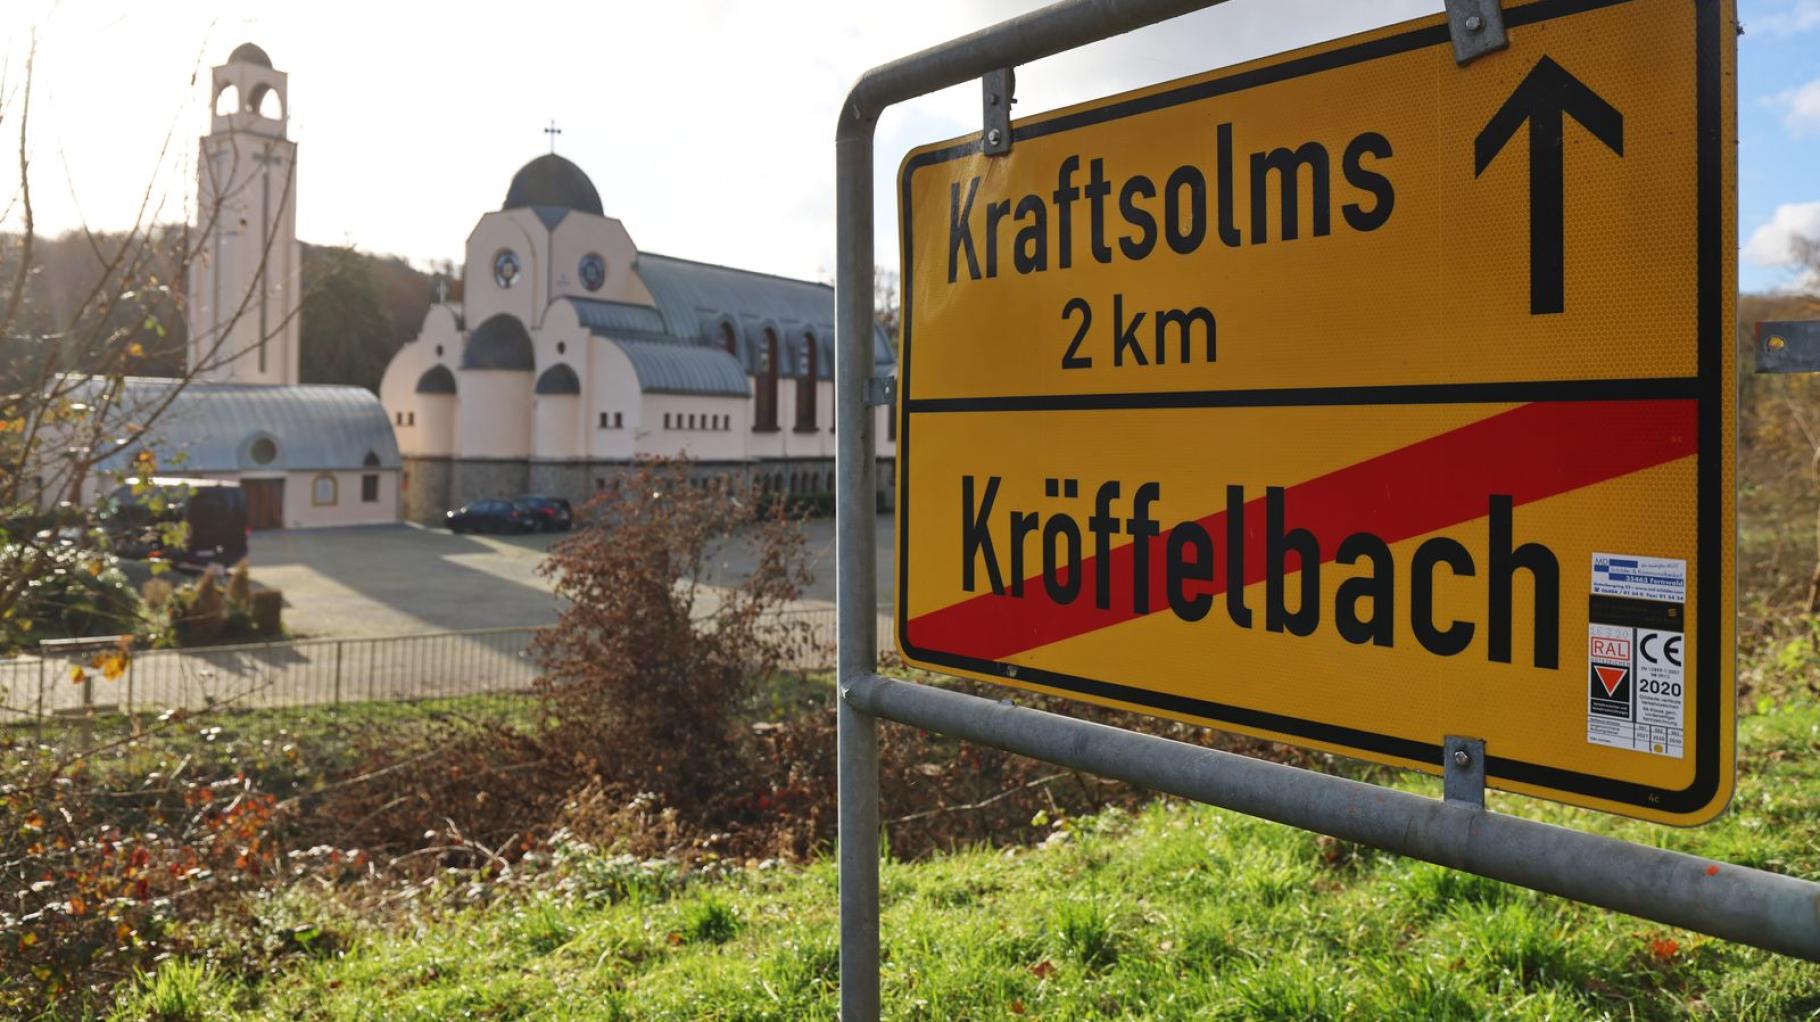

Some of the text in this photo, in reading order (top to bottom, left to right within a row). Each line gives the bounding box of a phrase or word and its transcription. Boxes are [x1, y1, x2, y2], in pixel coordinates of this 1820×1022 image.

[949, 122, 1394, 282] Kraftsolms
[1063, 295, 1216, 369] 2 km
[961, 475, 1560, 670] Kröffelbach
[1594, 640, 1626, 657] RAL
[1640, 634, 1681, 666] CE
[1640, 679, 1681, 696] 2020
